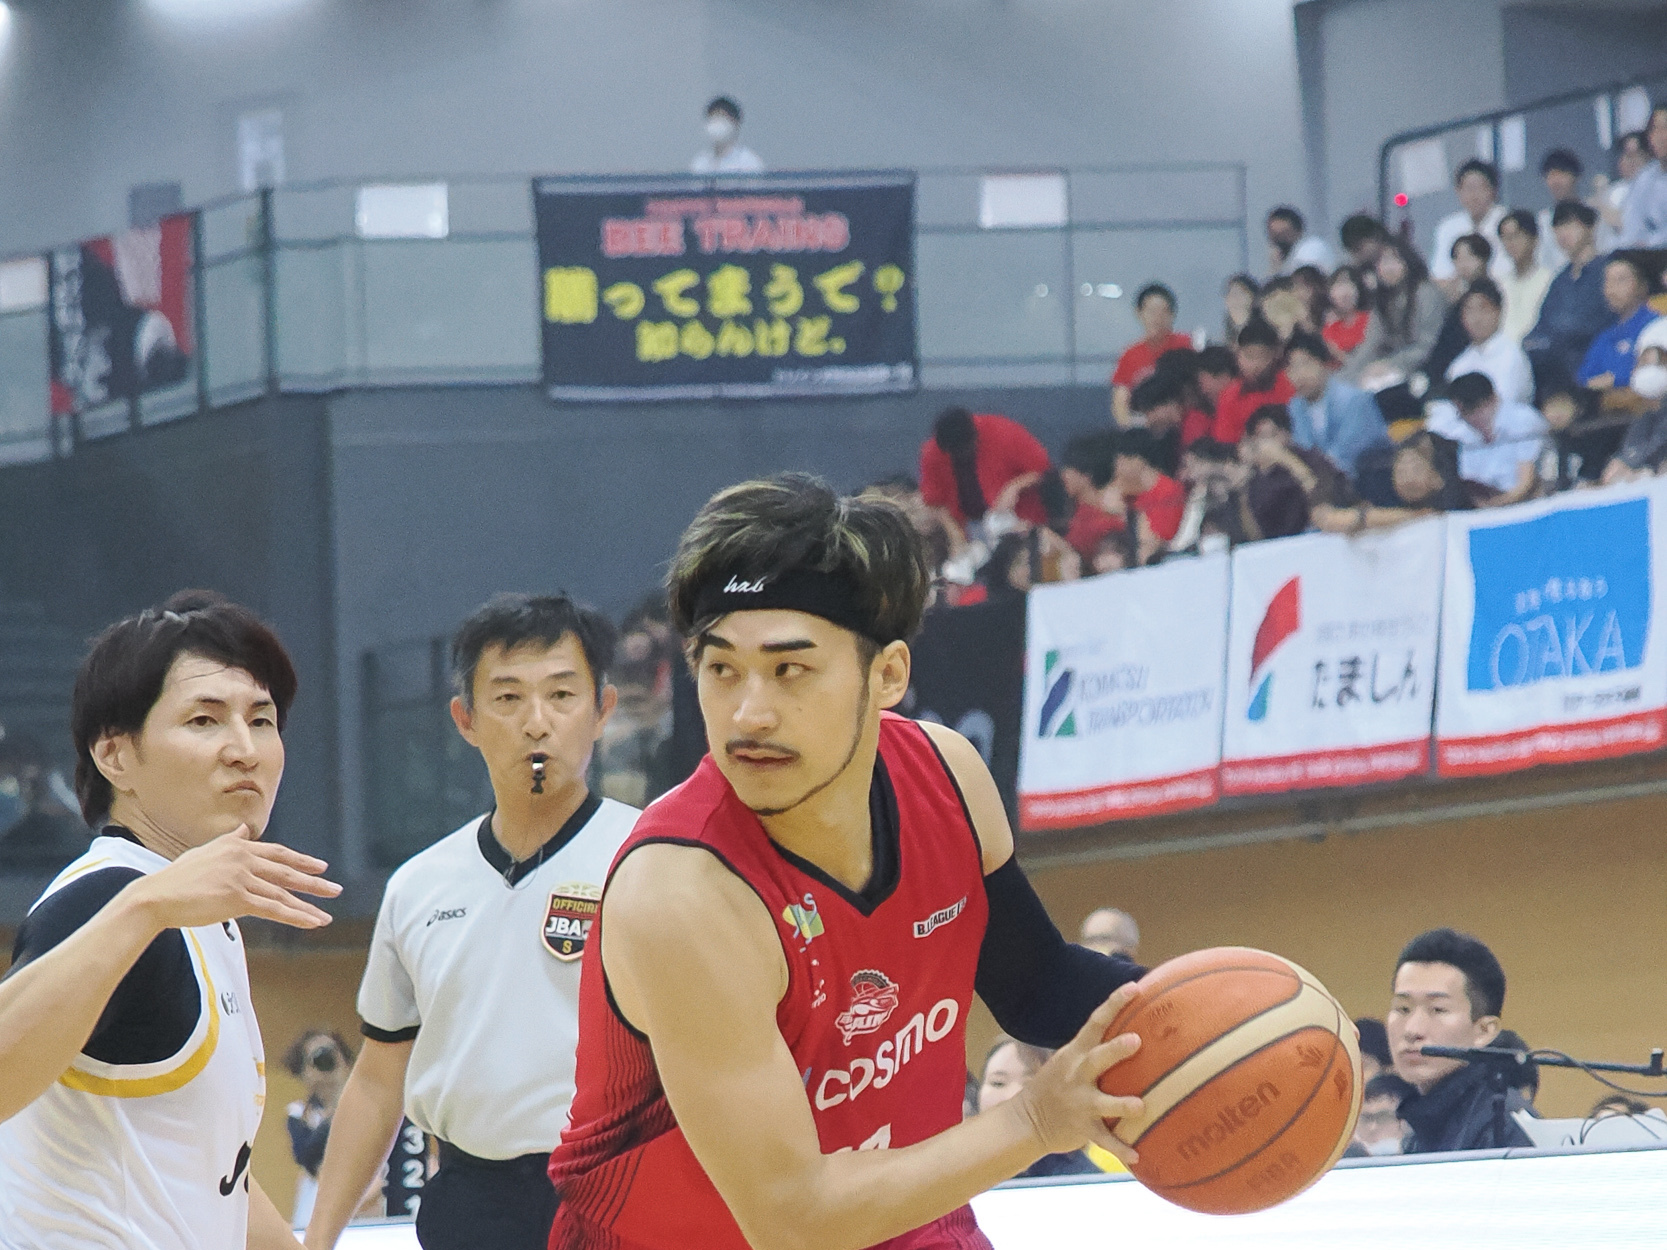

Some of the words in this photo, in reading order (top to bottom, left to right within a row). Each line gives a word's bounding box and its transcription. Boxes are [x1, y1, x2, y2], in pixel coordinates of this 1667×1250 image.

[1313, 650, 1419, 709] たましん
[553, 898, 598, 914] OFFICIA
[545, 916, 582, 937] JBA
[562, 940, 573, 954] S
[1176, 1080, 1282, 1161] molten
[402, 1124, 426, 1155] 3
[402, 1158, 426, 1189] 2
